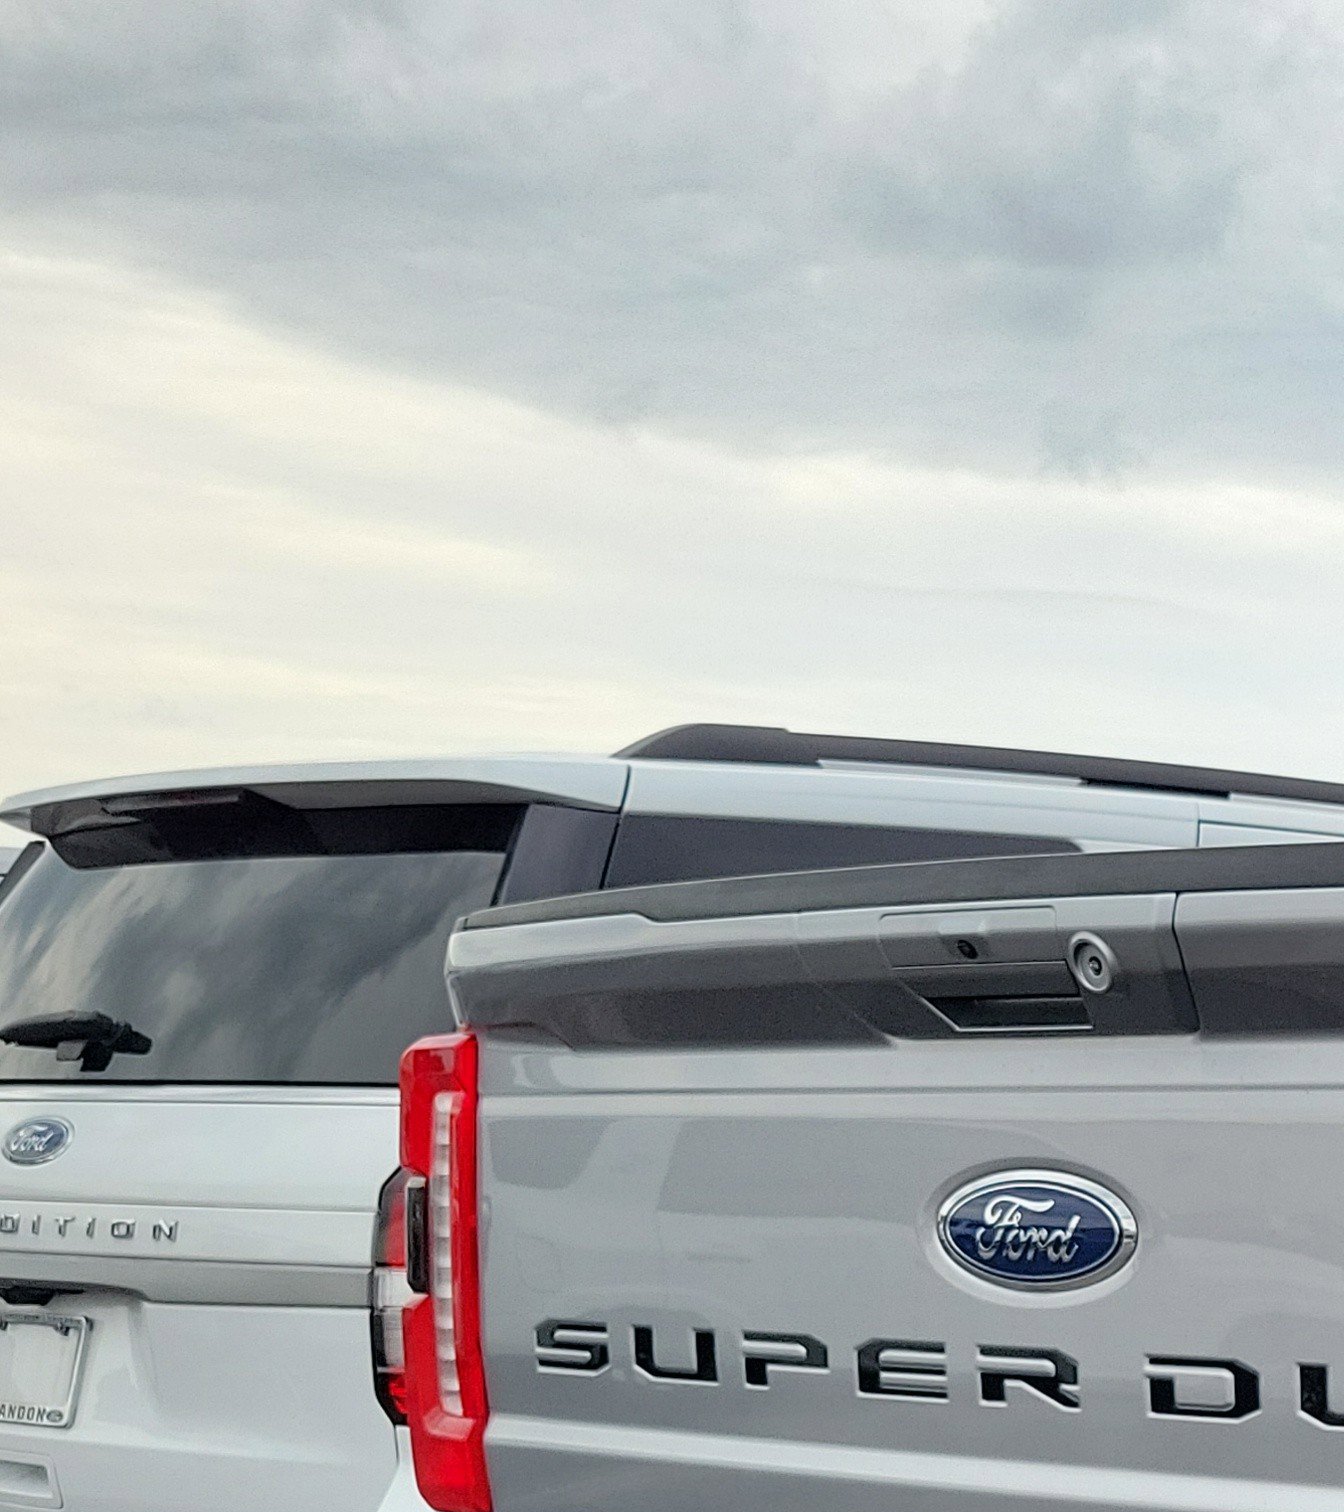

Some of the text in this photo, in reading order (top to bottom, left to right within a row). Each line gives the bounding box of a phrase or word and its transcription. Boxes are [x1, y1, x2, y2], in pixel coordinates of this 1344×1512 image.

[0, 1211, 179, 1242] DITION
[976, 1194, 1080, 1263] Ford
[534, 1318, 1082, 1412] SUPER
